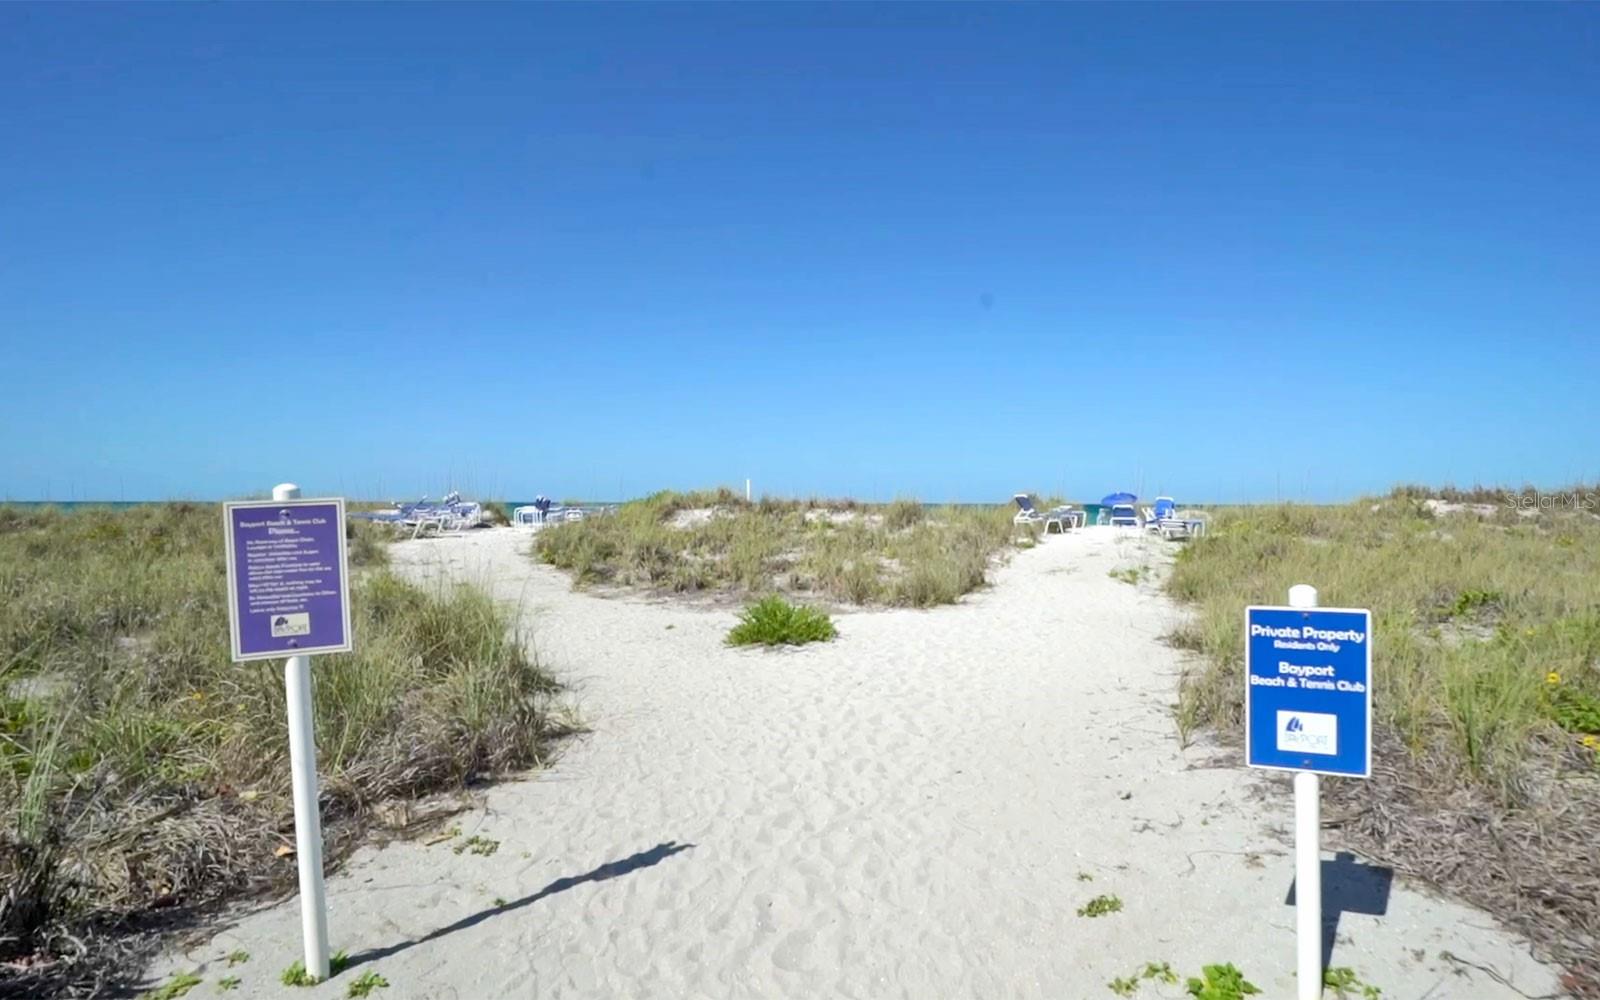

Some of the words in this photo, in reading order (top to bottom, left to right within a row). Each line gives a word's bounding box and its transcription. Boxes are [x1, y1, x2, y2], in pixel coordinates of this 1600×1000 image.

[1251, 624, 1300, 638] Private
[1302, 626, 1365, 643] Property
[1273, 640, 1316, 650] Residents
[1317, 642, 1340, 653] Only
[1278, 661, 1335, 677] Bayport
[1250, 675, 1285, 687] Beach
[1286, 677, 1298, 688] &
[1299, 678, 1335, 690] Tennis
[1336, 680, 1365, 692] Club
